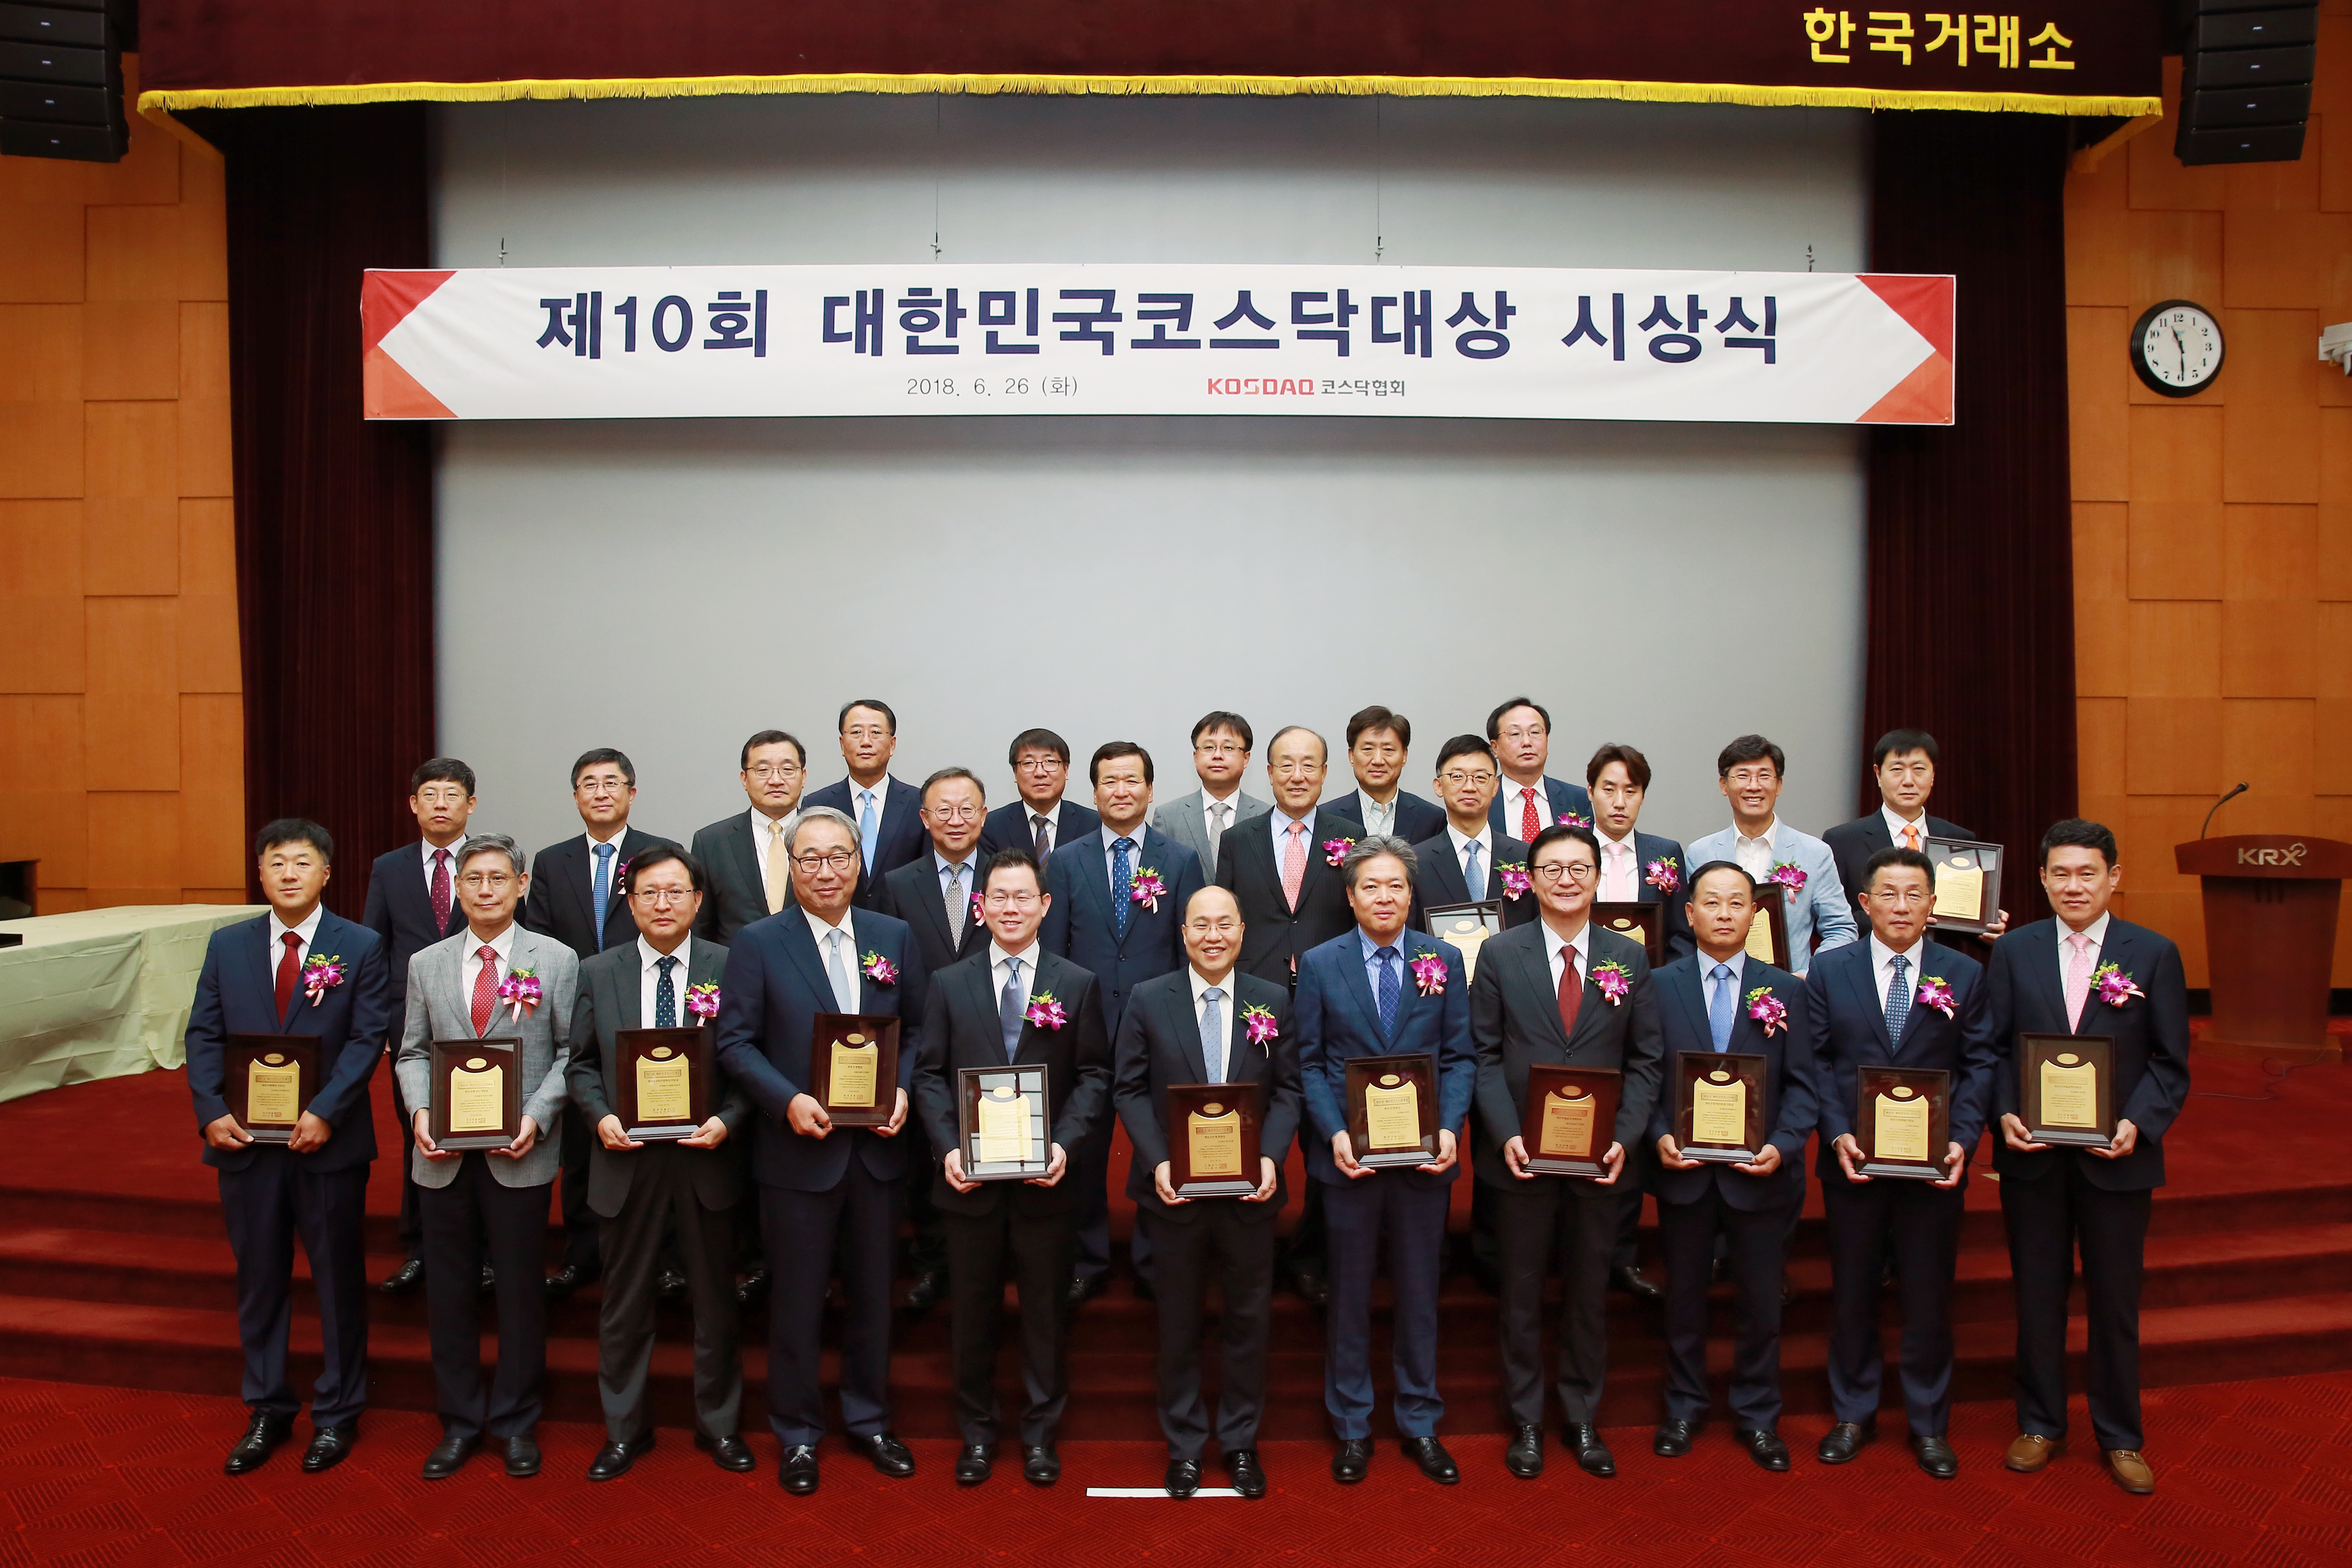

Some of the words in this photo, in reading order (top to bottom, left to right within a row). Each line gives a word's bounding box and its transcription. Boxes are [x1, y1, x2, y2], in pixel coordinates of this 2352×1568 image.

[1804, 8, 2074, 69] 한국거래소
[2160, 318, 2167, 327] 11
[2173, 314, 2184, 323] 12
[2192, 317, 2196, 326] 1
[536, 290, 767, 359] 제10회
[823, 288, 1516, 359] 대한민국코스닥대상
[1561, 293, 1776, 364] 시상식
[2149, 330, 2159, 339] 10
[2201, 327, 2208, 336] 2
[2147, 344, 2154, 352] 9
[2205, 343, 2212, 351] 3
[2201, 358, 2206, 367] 4
[2164, 371, 2169, 379] 7
[2177, 373, 2183, 382] 6
[2192, 370, 2198, 378] 5
[908, 379, 959, 396] 2018.
[975, 379, 990, 396] 6.
[1006, 378, 1028, 394] 26
[1042, 377, 1077, 396] (화)
[1208, 379, 1314, 395] KOSDAQ
[1322, 380, 1404, 396] 코스닥협회
[2238, 842, 2307, 866] KRX
